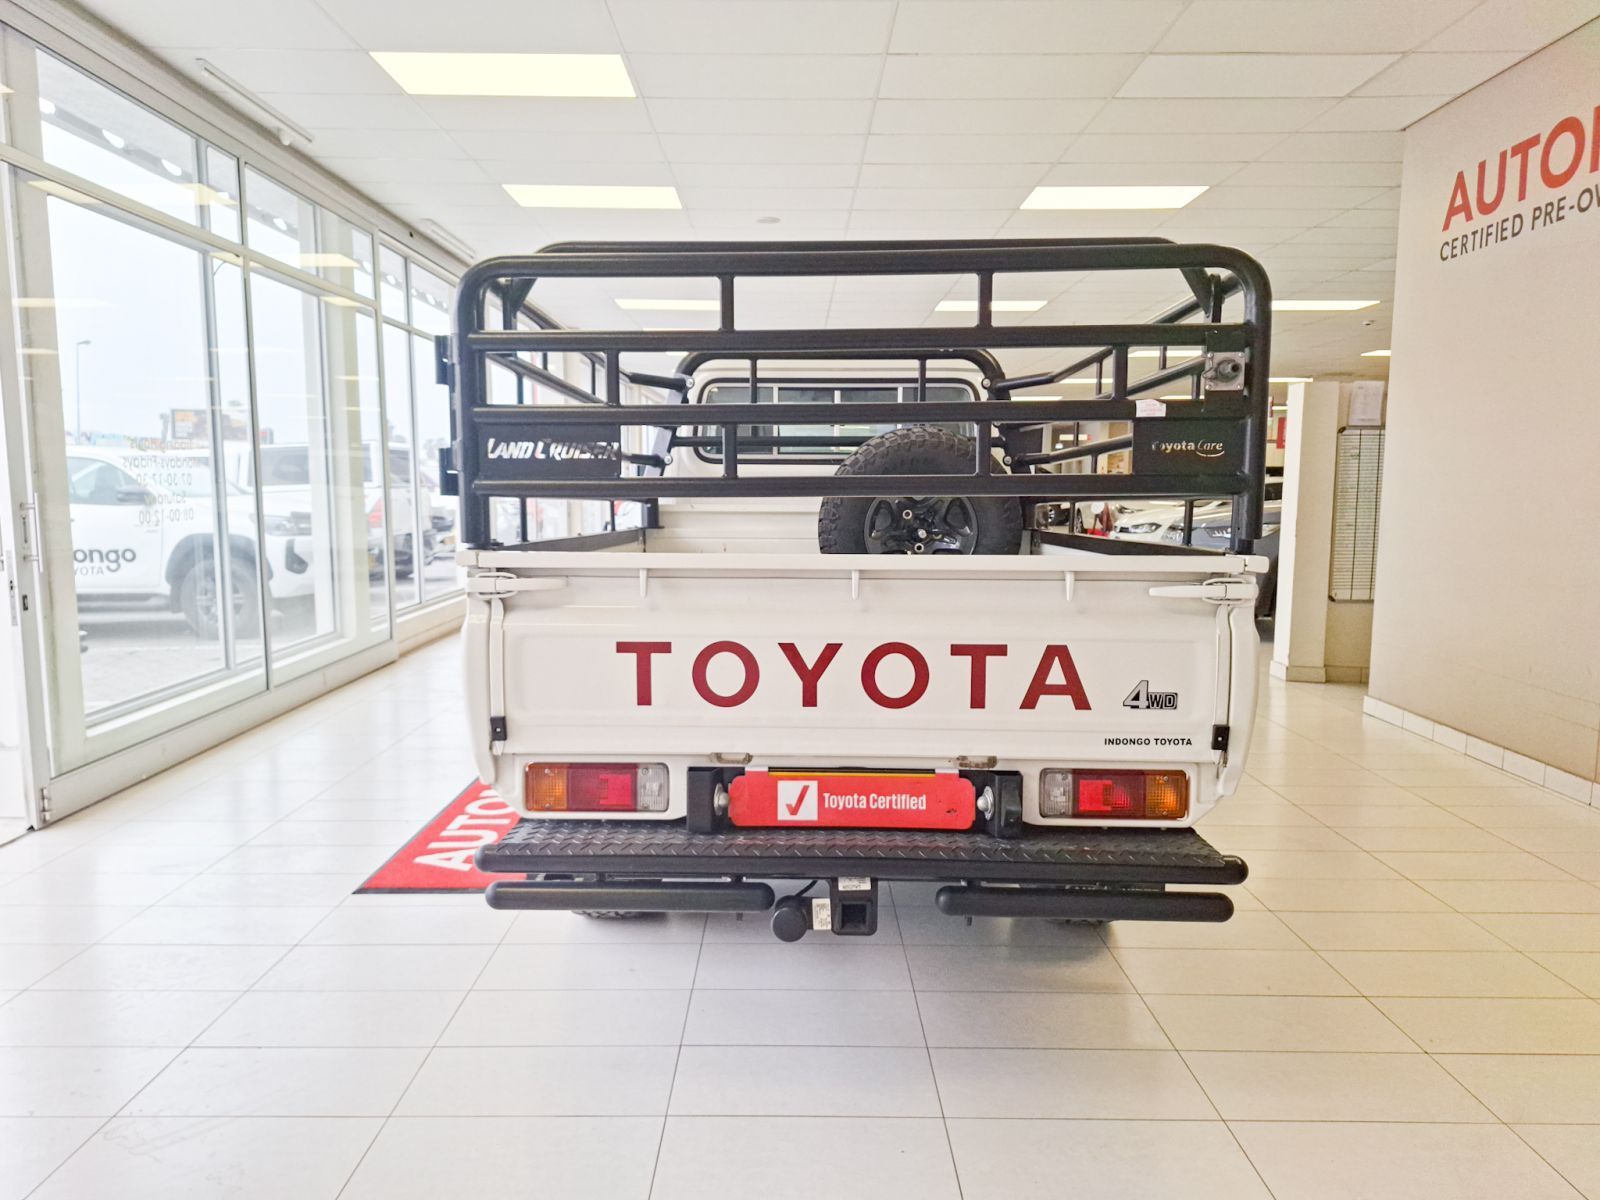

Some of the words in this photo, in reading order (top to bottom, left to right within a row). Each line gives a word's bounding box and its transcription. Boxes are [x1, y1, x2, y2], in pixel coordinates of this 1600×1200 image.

[1440, 213, 1524, 261] CERTIFIED
[487, 438, 535, 460] LAND
[73, 548, 137, 573] ongo
[73, 565, 104, 576] YOTA
[615, 640, 1092, 711] TOYOTA
[1123, 679, 1178, 710] 4WD
[1104, 737, 1151, 747] INDONGO
[1154, 737, 1192, 747] TOYOTA
[823, 792, 867, 811] Toyota
[869, 793, 927, 811] Certified
